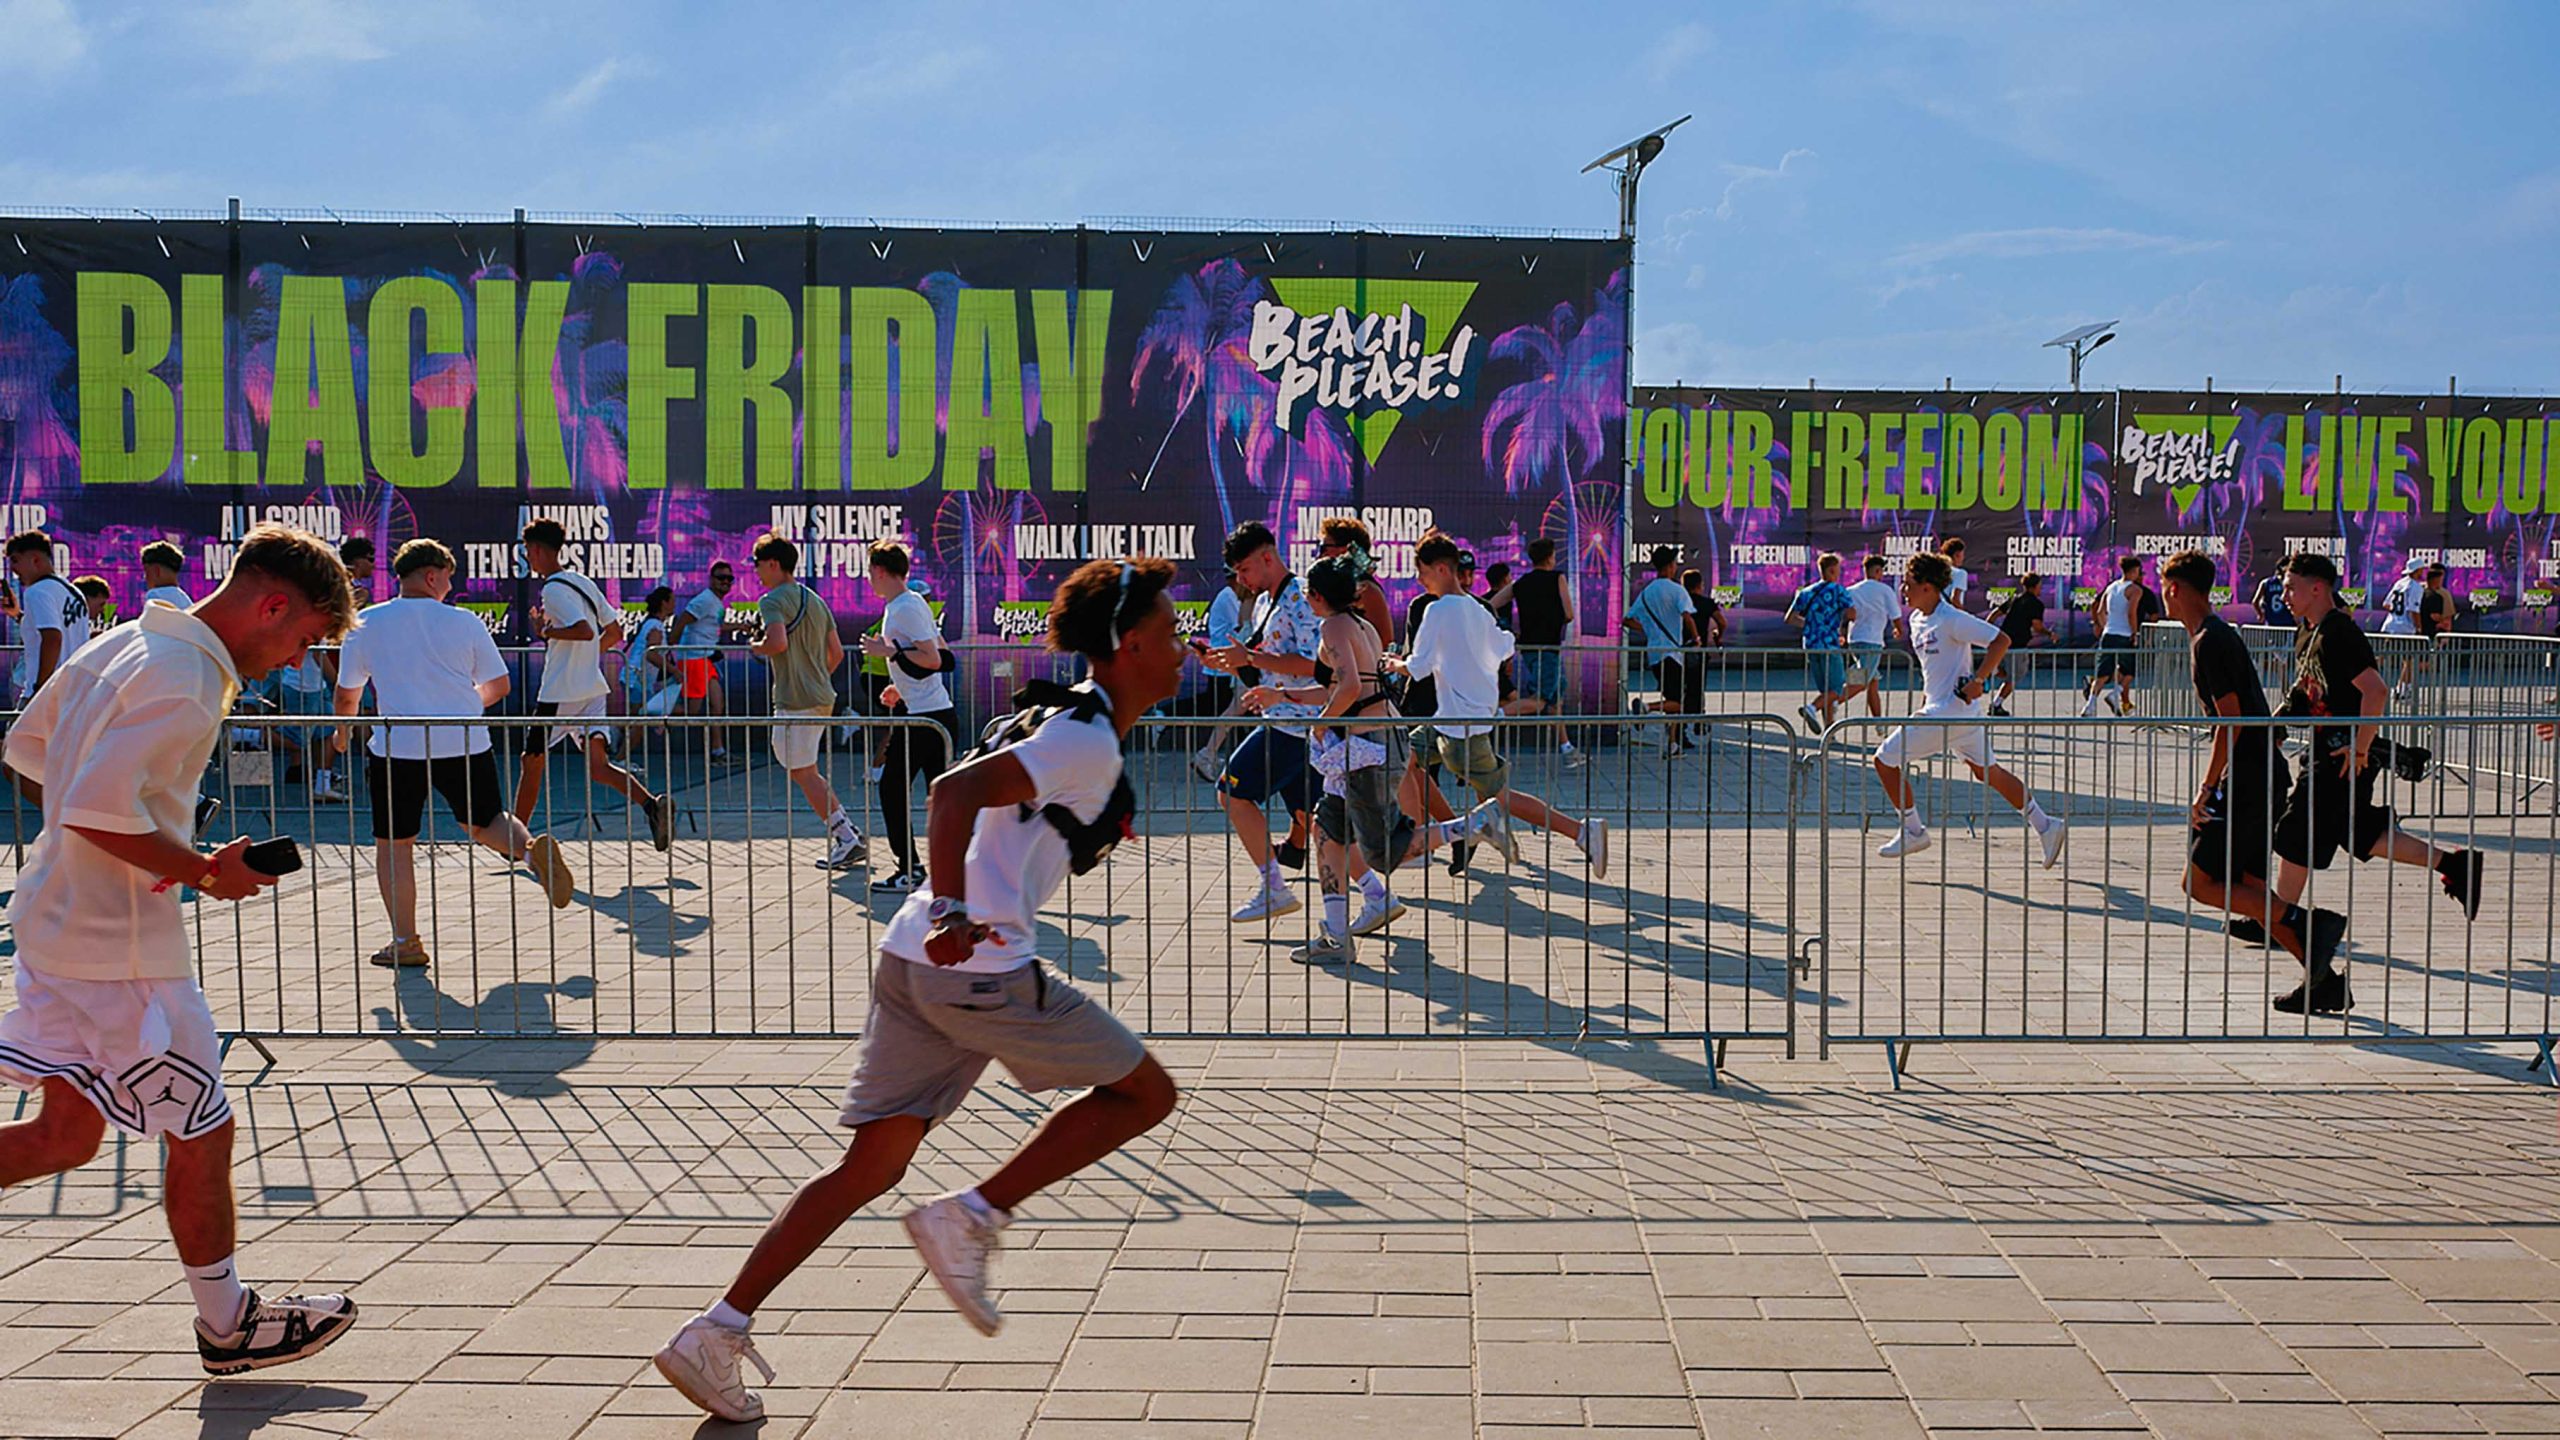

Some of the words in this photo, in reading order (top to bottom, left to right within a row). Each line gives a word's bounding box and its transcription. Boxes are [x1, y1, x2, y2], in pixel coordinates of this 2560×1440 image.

[76, 271, 571, 489] BLACK
[627, 283, 1113, 491] FRIDAY
[1275, 324, 1473, 432] PLEASE!
[1791, 411, 2084, 511] FREEDOM
[2133, 438, 2239, 496] PLEASE!
[2283, 415, 2411, 512] LIVE
[772, 505, 807, 540] MY
[810, 504, 903, 541] SILENCE
[1362, 507, 1433, 542] SHARP
[1014, 525, 1077, 560] WALK
[1080, 525, 1126, 560] LIKE
[1130, 525, 1138, 558] I
[1141, 525, 1195, 560] TALK
[1755, 545, 1785, 565] BEEN
[1885, 536, 1918, 556] MAKE
[1920, 536, 1934, 554] IT
[2007, 536, 2044, 556] CLEAN
[2136, 535, 2185, 554] RESPECT
[2284, 537, 2305, 556] THE
[2307, 537, 2346, 556] VISION
[2443, 549, 2486, 568] CHOSEN
[464, 543, 508, 579] TEN
[589, 543, 663, 579] AHEAD
[2007, 557, 2033, 576] FULL
[2035, 557, 2082, 576] HUNGER
